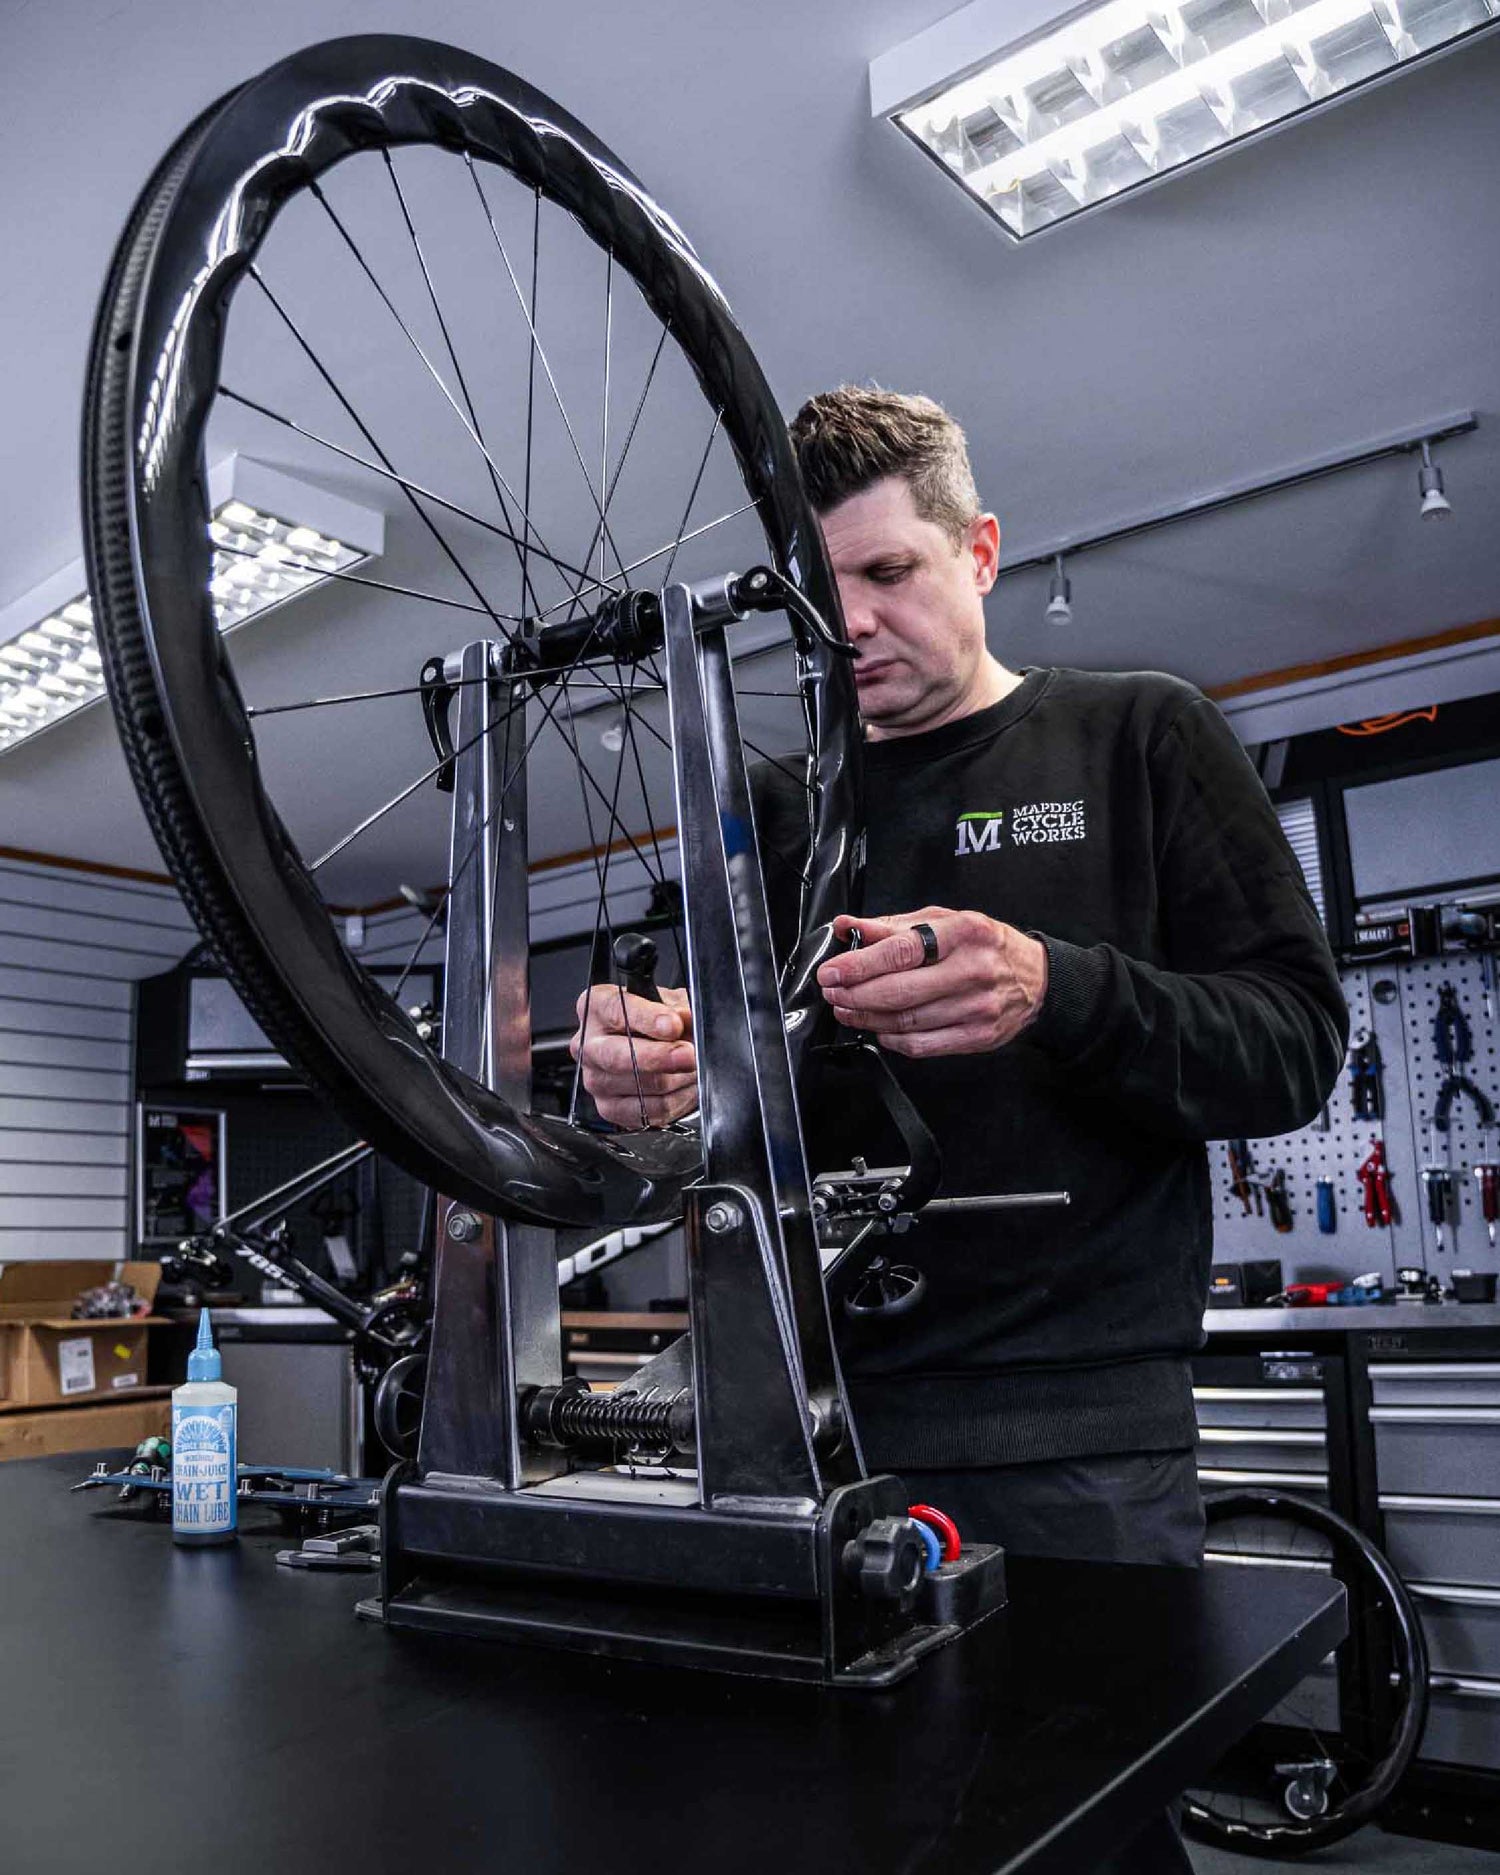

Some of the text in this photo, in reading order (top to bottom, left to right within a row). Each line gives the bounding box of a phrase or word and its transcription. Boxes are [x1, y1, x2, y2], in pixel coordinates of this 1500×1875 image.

[1013, 800, 1084, 818] MAPDEC
[1012, 811, 1085, 832] CYCLE
[1011, 826, 1086, 846] WORKS
[175, 1480, 227, 1501] WET
[175, 1501, 229, 1524] CHAIN LUBE
